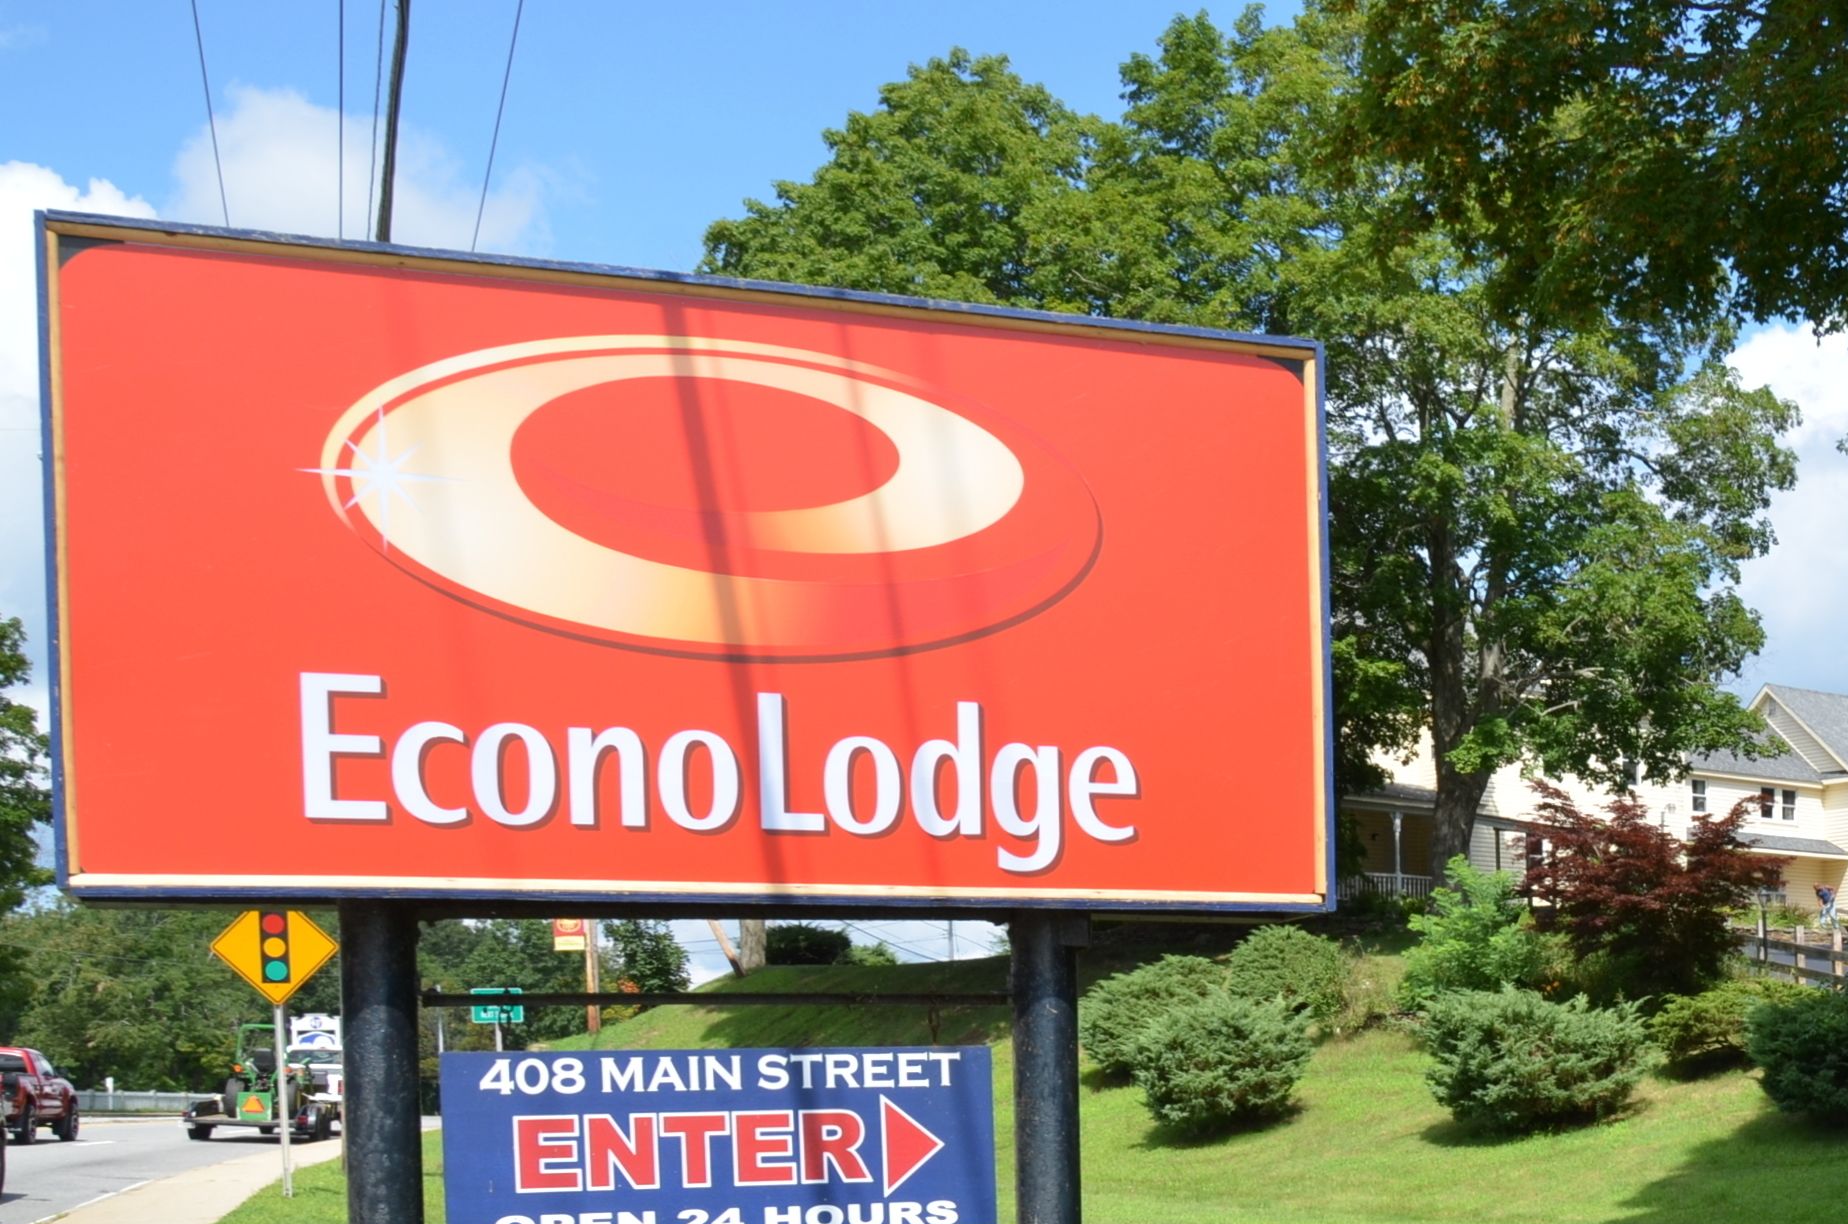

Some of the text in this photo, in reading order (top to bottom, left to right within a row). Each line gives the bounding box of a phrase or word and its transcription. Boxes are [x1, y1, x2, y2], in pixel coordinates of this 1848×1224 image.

[479, 1051, 961, 1096] 408 MAIN STREET
[512, 1108, 874, 1194] ENTER
